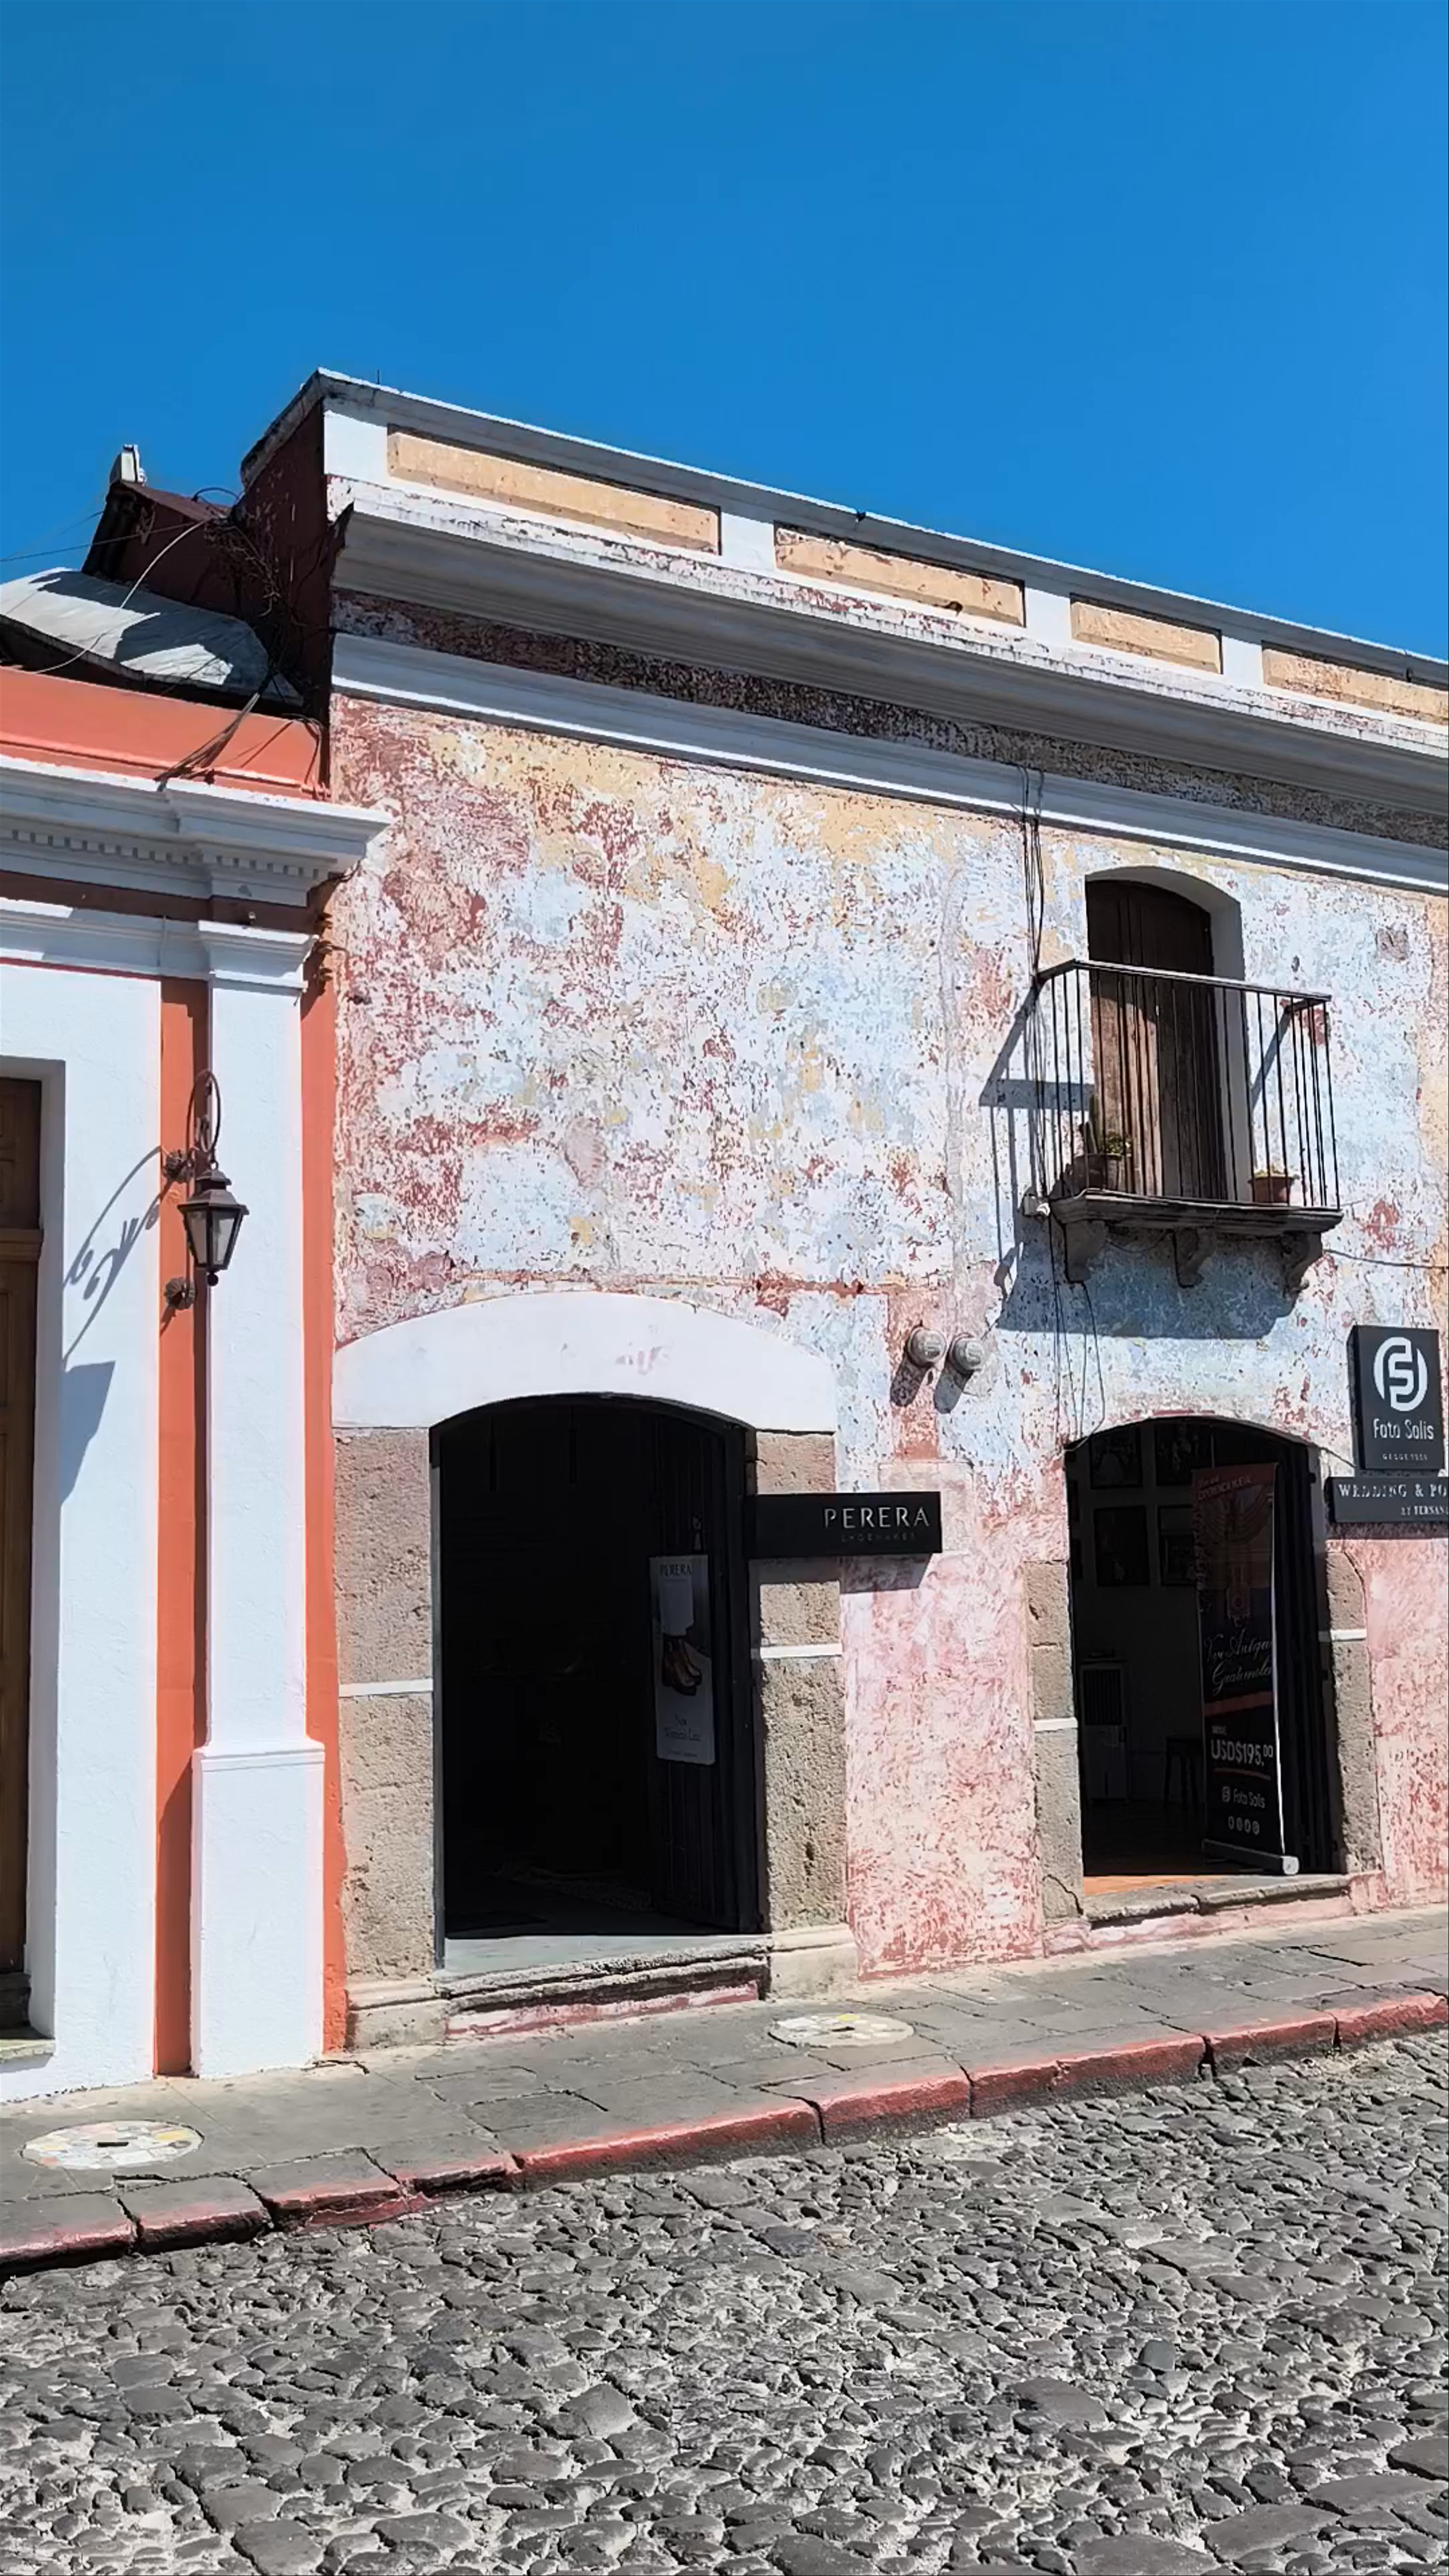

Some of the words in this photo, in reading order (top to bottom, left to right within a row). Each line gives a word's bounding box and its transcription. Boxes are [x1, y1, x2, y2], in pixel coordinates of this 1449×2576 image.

[1338, 1484, 1407, 1498] WEDDING
[1414, 1483, 1424, 1498] &
[824, 1507, 930, 1529] PERERA
[660, 1563, 692, 1577] PERERA
